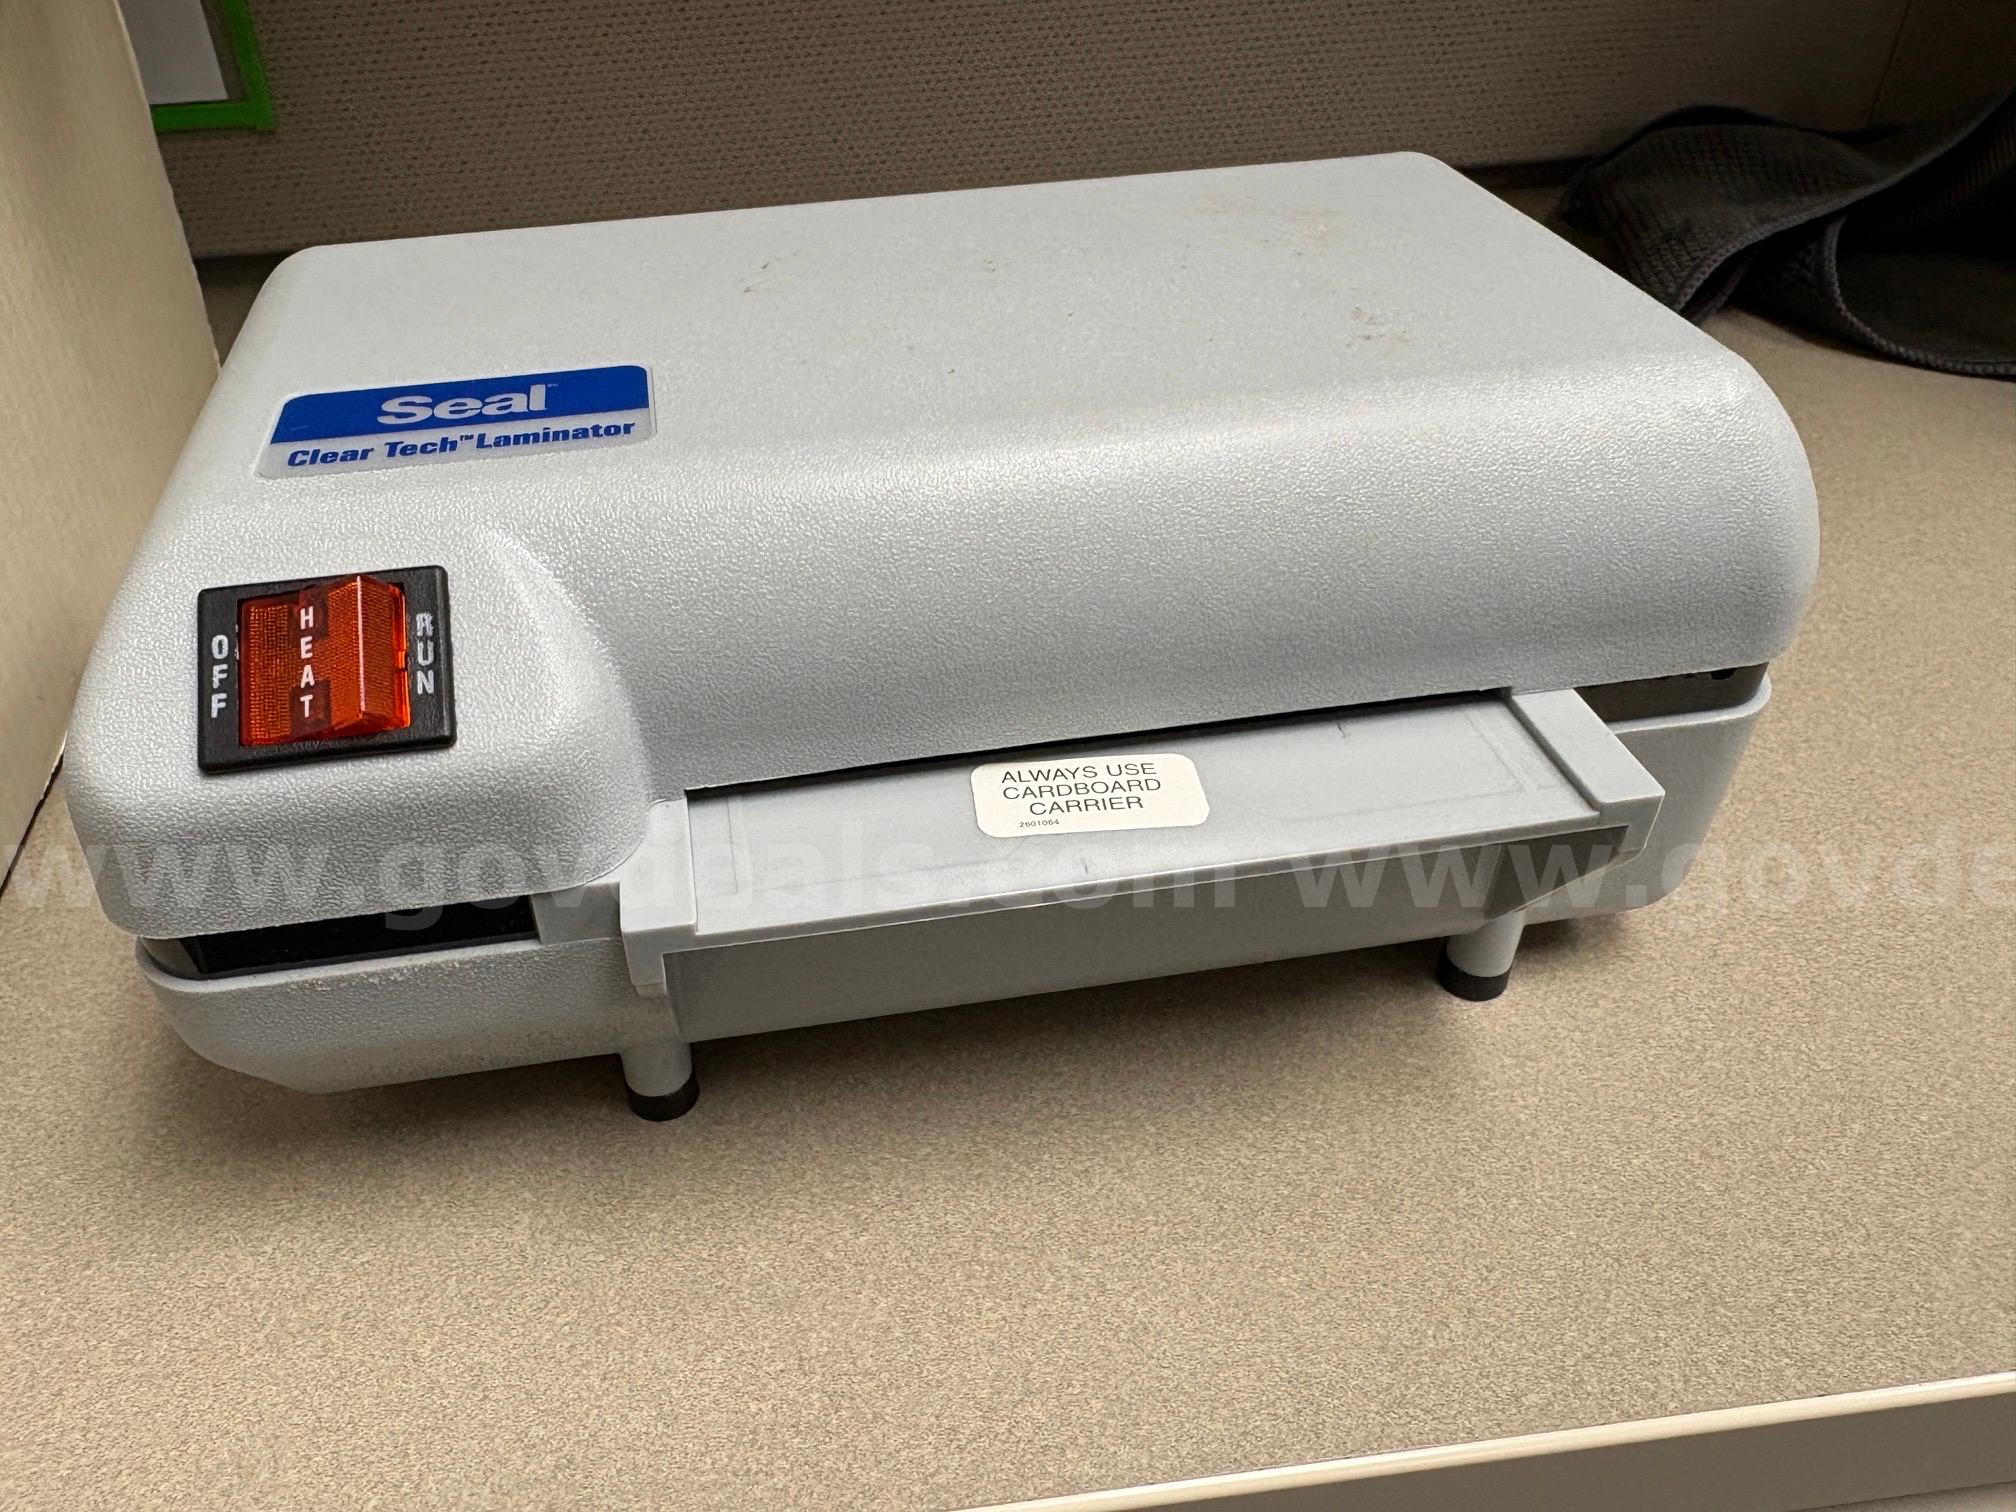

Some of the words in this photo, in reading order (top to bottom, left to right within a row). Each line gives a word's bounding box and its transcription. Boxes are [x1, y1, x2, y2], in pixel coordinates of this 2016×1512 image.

[376, 383, 548, 425] Seal
[287, 447, 375, 467] Clear
[475, 421, 636, 450] Laminator
[299, 605, 316, 719] HEAT
[415, 612, 435, 695] RUN
[210, 633, 229, 719] OFF
[1001, 765, 1098, 784] ALWAYS
[1106, 762, 1158, 778] USE
[1002, 778, 1162, 800] CARDBOARD
[1029, 795, 1144, 816] CARRIER
